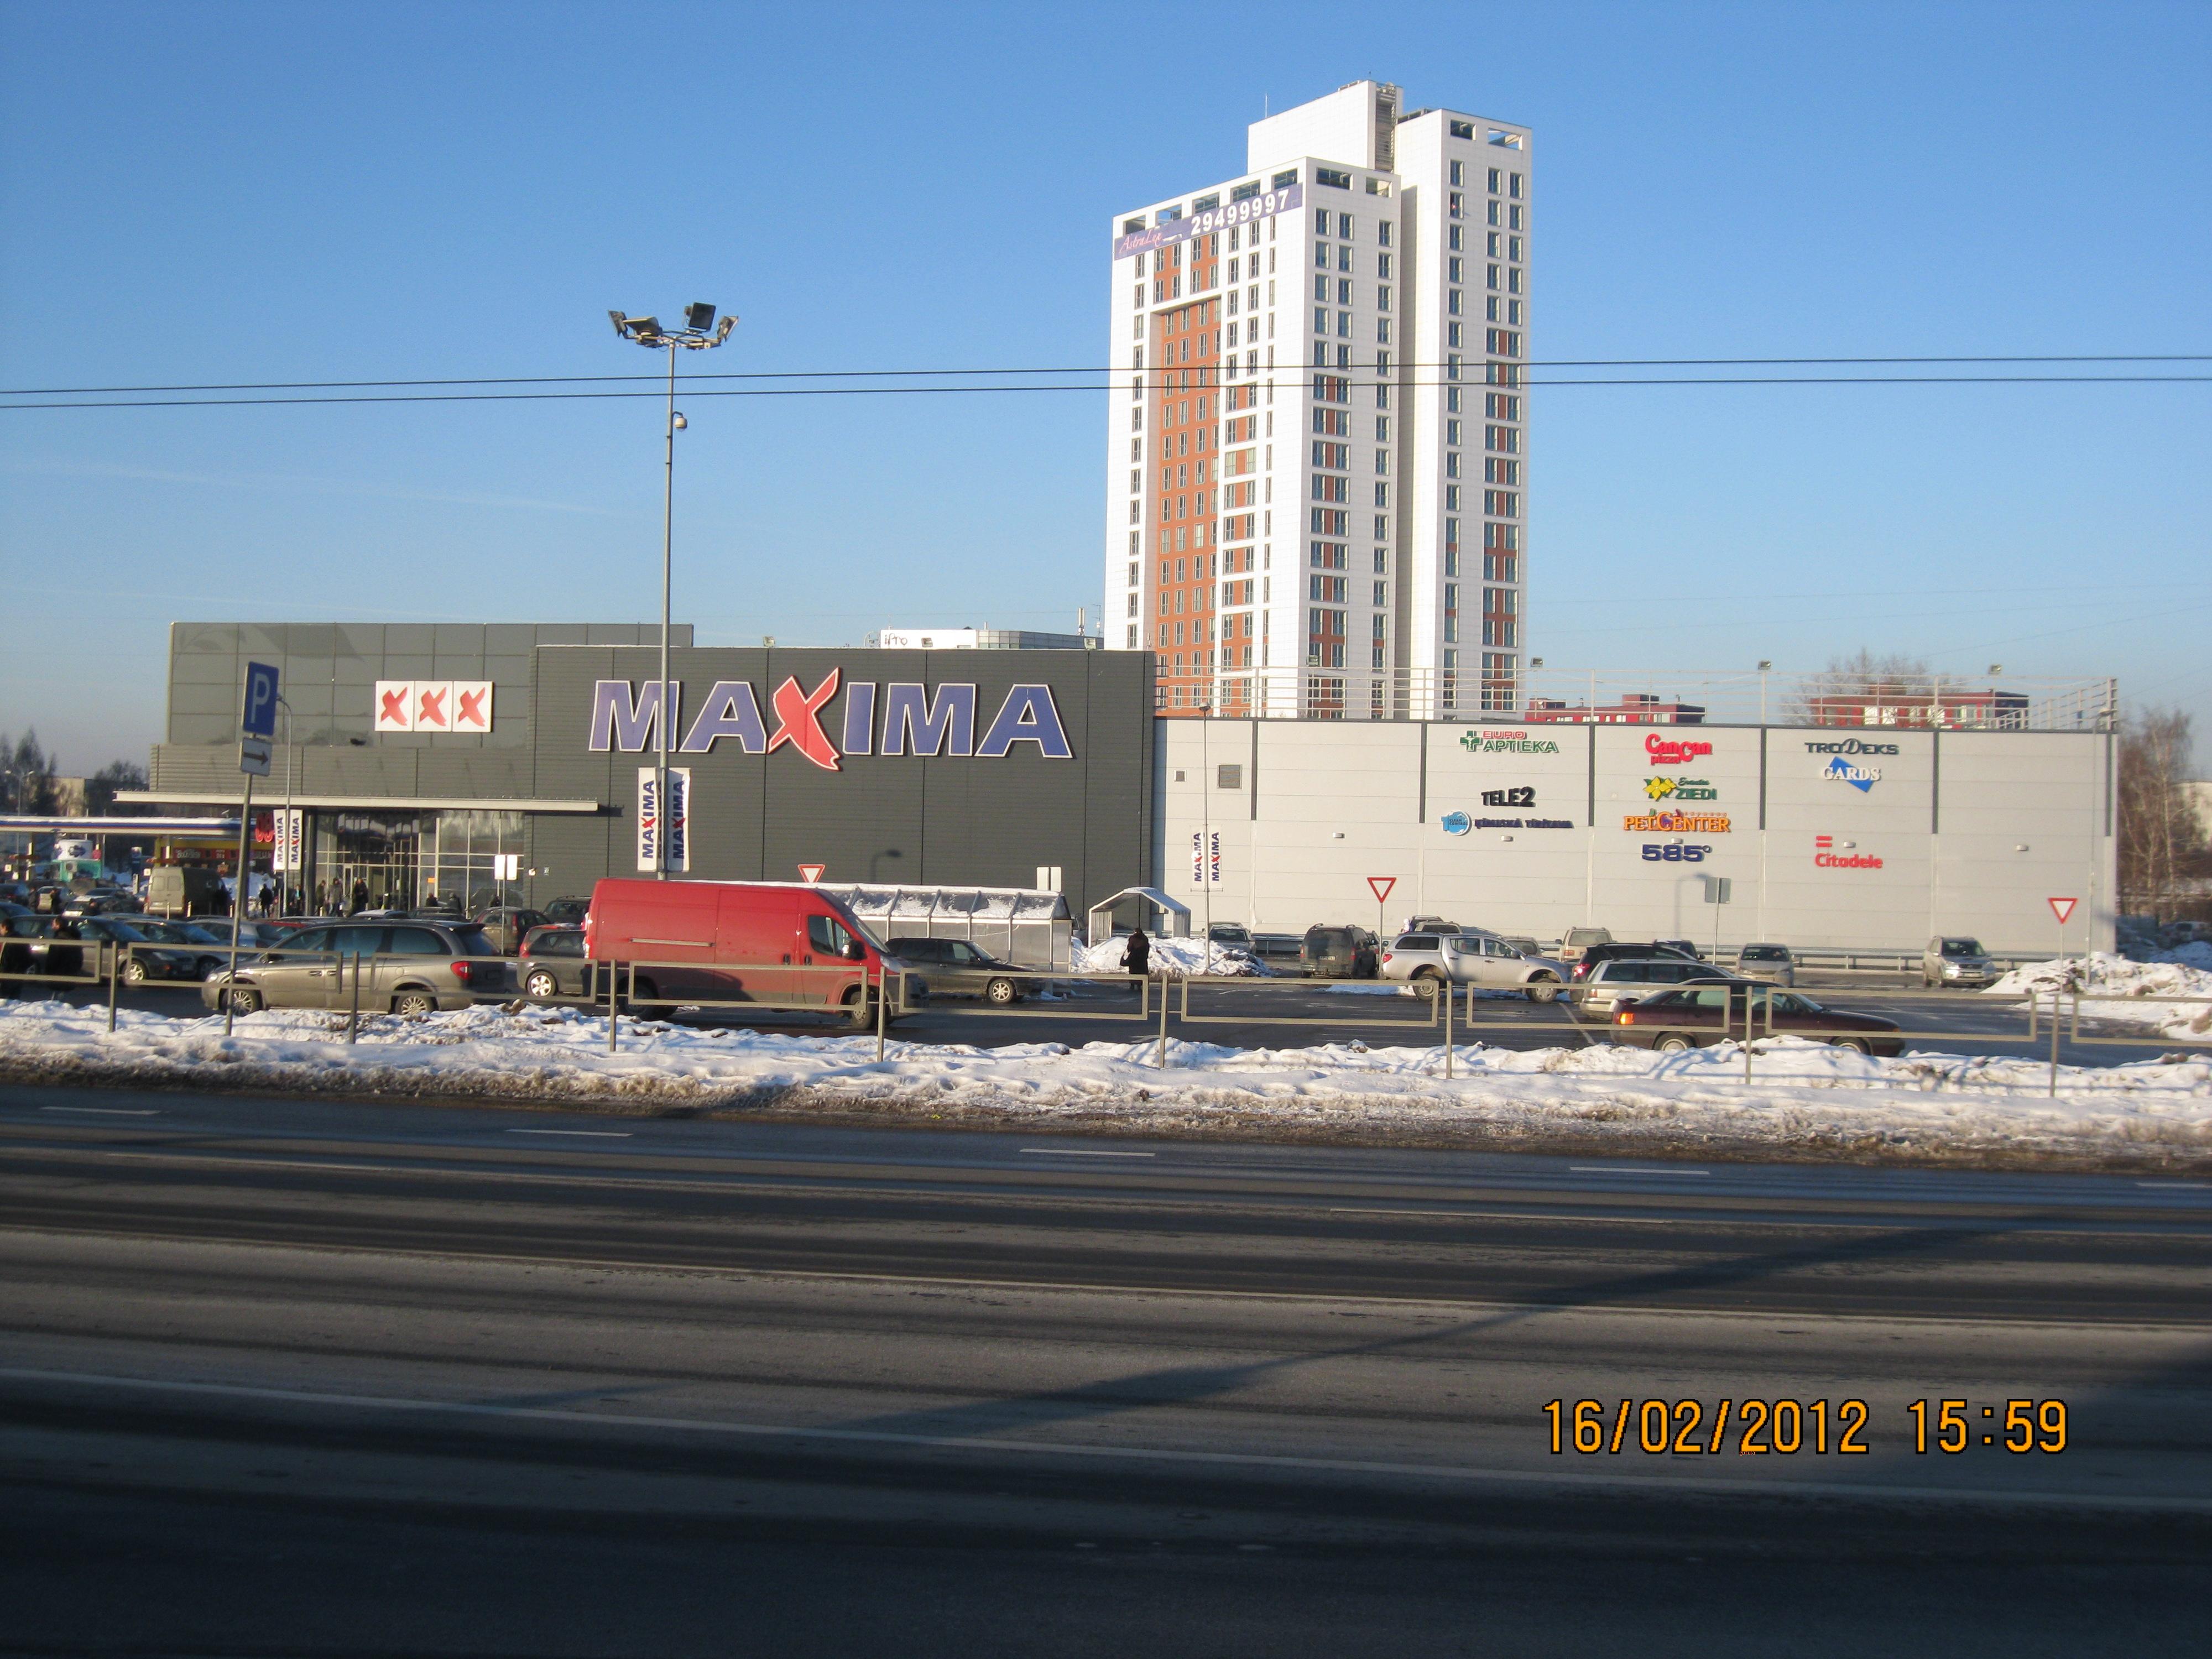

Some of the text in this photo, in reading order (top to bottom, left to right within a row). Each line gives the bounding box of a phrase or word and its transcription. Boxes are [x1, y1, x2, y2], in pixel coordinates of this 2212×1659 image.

[1191, 189, 1289, 235] 29499997
[251, 674, 270, 723] P
[588, 667, 1074, 772] MAXIMA
[1483, 731, 1526, 739] EURO
[1483, 740, 1558, 753] APTIEKA
[1645, 733, 1713, 761] CanCan
[1823, 766, 1881, 781] GARDS
[1481, 786, 1536, 807] TELE2
[1675, 788, 1717, 800] ZIEDI
[641, 780, 656, 858] MAXIMA
[671, 780, 686, 859] MAXIMA
[291, 817, 300, 863] MAXIMA
[1211, 832, 1220, 881] MAXIMA
[1815, 853, 1883, 868] Citadele
